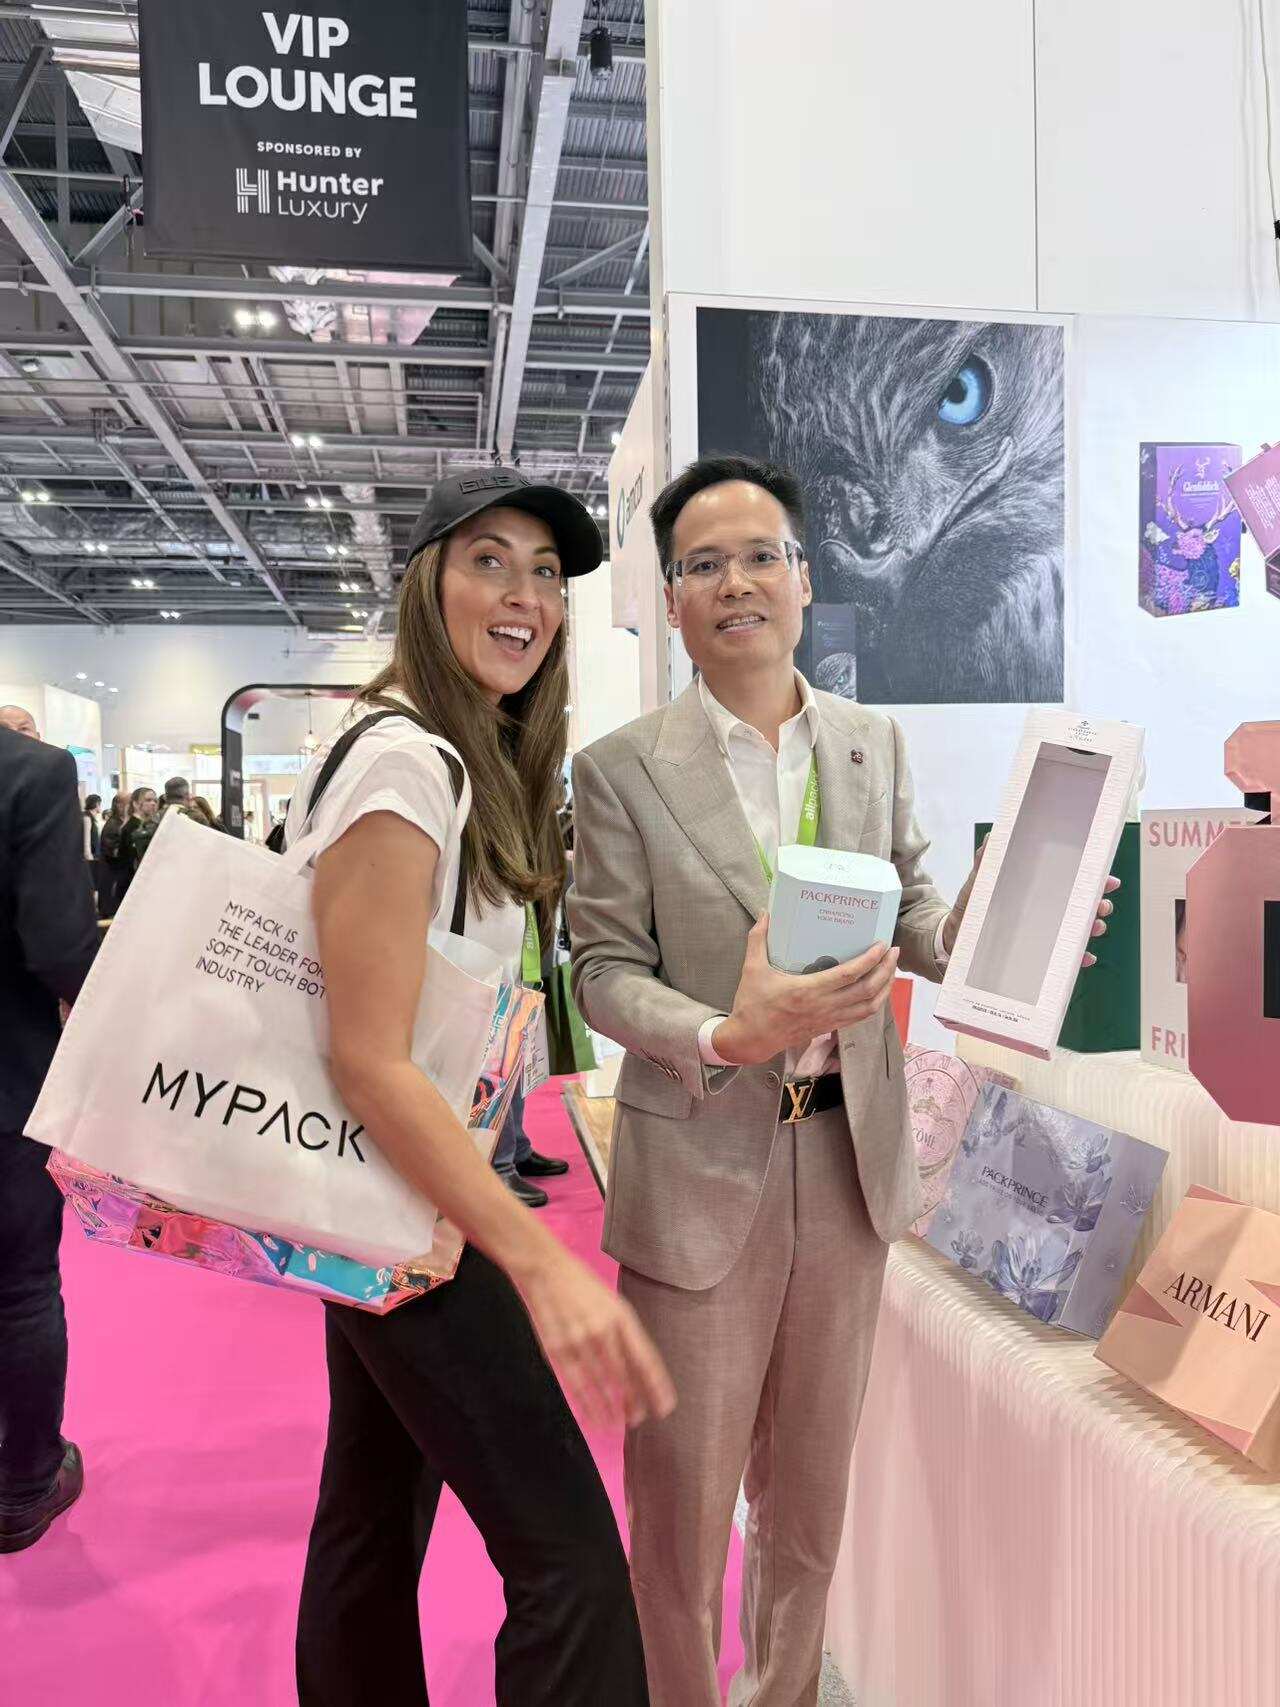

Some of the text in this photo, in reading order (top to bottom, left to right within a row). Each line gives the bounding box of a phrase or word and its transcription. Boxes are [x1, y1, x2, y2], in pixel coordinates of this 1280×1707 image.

[262, 12, 350, 58] VIP
[198, 62, 418, 119] LOUNGE
[257, 140, 362, 159] SPONSORED BY
[277, 170, 384, 197] Hunter
[278, 195, 368, 224] Luxury
[1149, 820, 1242, 847] SUMM
[800, 889, 879, 910] PACKPRINCE
[218, 918, 244, 941] THE
[243, 931, 299, 966] LEADER
[225, 900, 299, 944] MYPACK IS
[195, 955, 265, 993] INDUSTRY
[205, 937, 244, 962] SOFT
[246, 953, 297, 986] TOUCH
[141, 1061, 366, 1163] MYPACK
[981, 1165, 1049, 1208] PACKPRINCE
[1163, 1271, 1271, 1342] ARMANI
